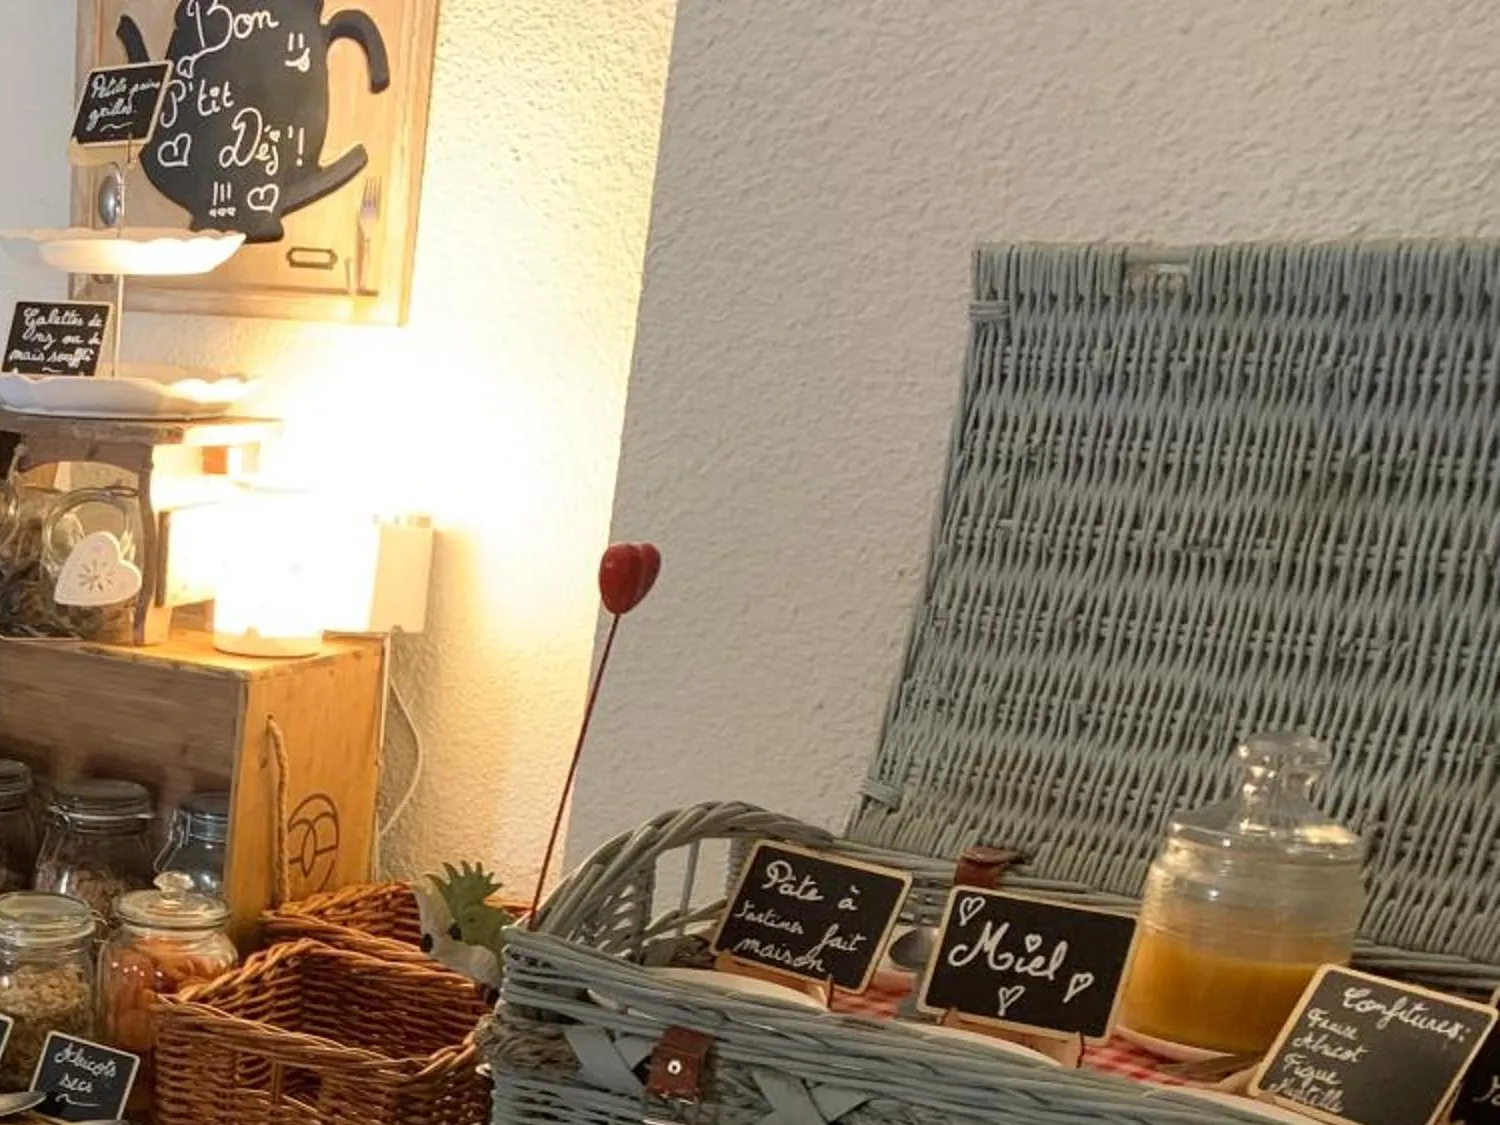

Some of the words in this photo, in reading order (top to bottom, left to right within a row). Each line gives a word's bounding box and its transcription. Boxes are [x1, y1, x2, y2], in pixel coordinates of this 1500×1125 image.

[175, 0, 280, 79] Bon
[160, 79, 235, 128] P'tit
[838, 884, 861, 911] à
[732, 937, 827, 973] maison
[802, 922, 868, 964] fait
[948, 920, 1069, 981] Miel
[1292, 1031, 1370, 1063] Abricot
[1282, 1052, 1344, 1094] Figue
